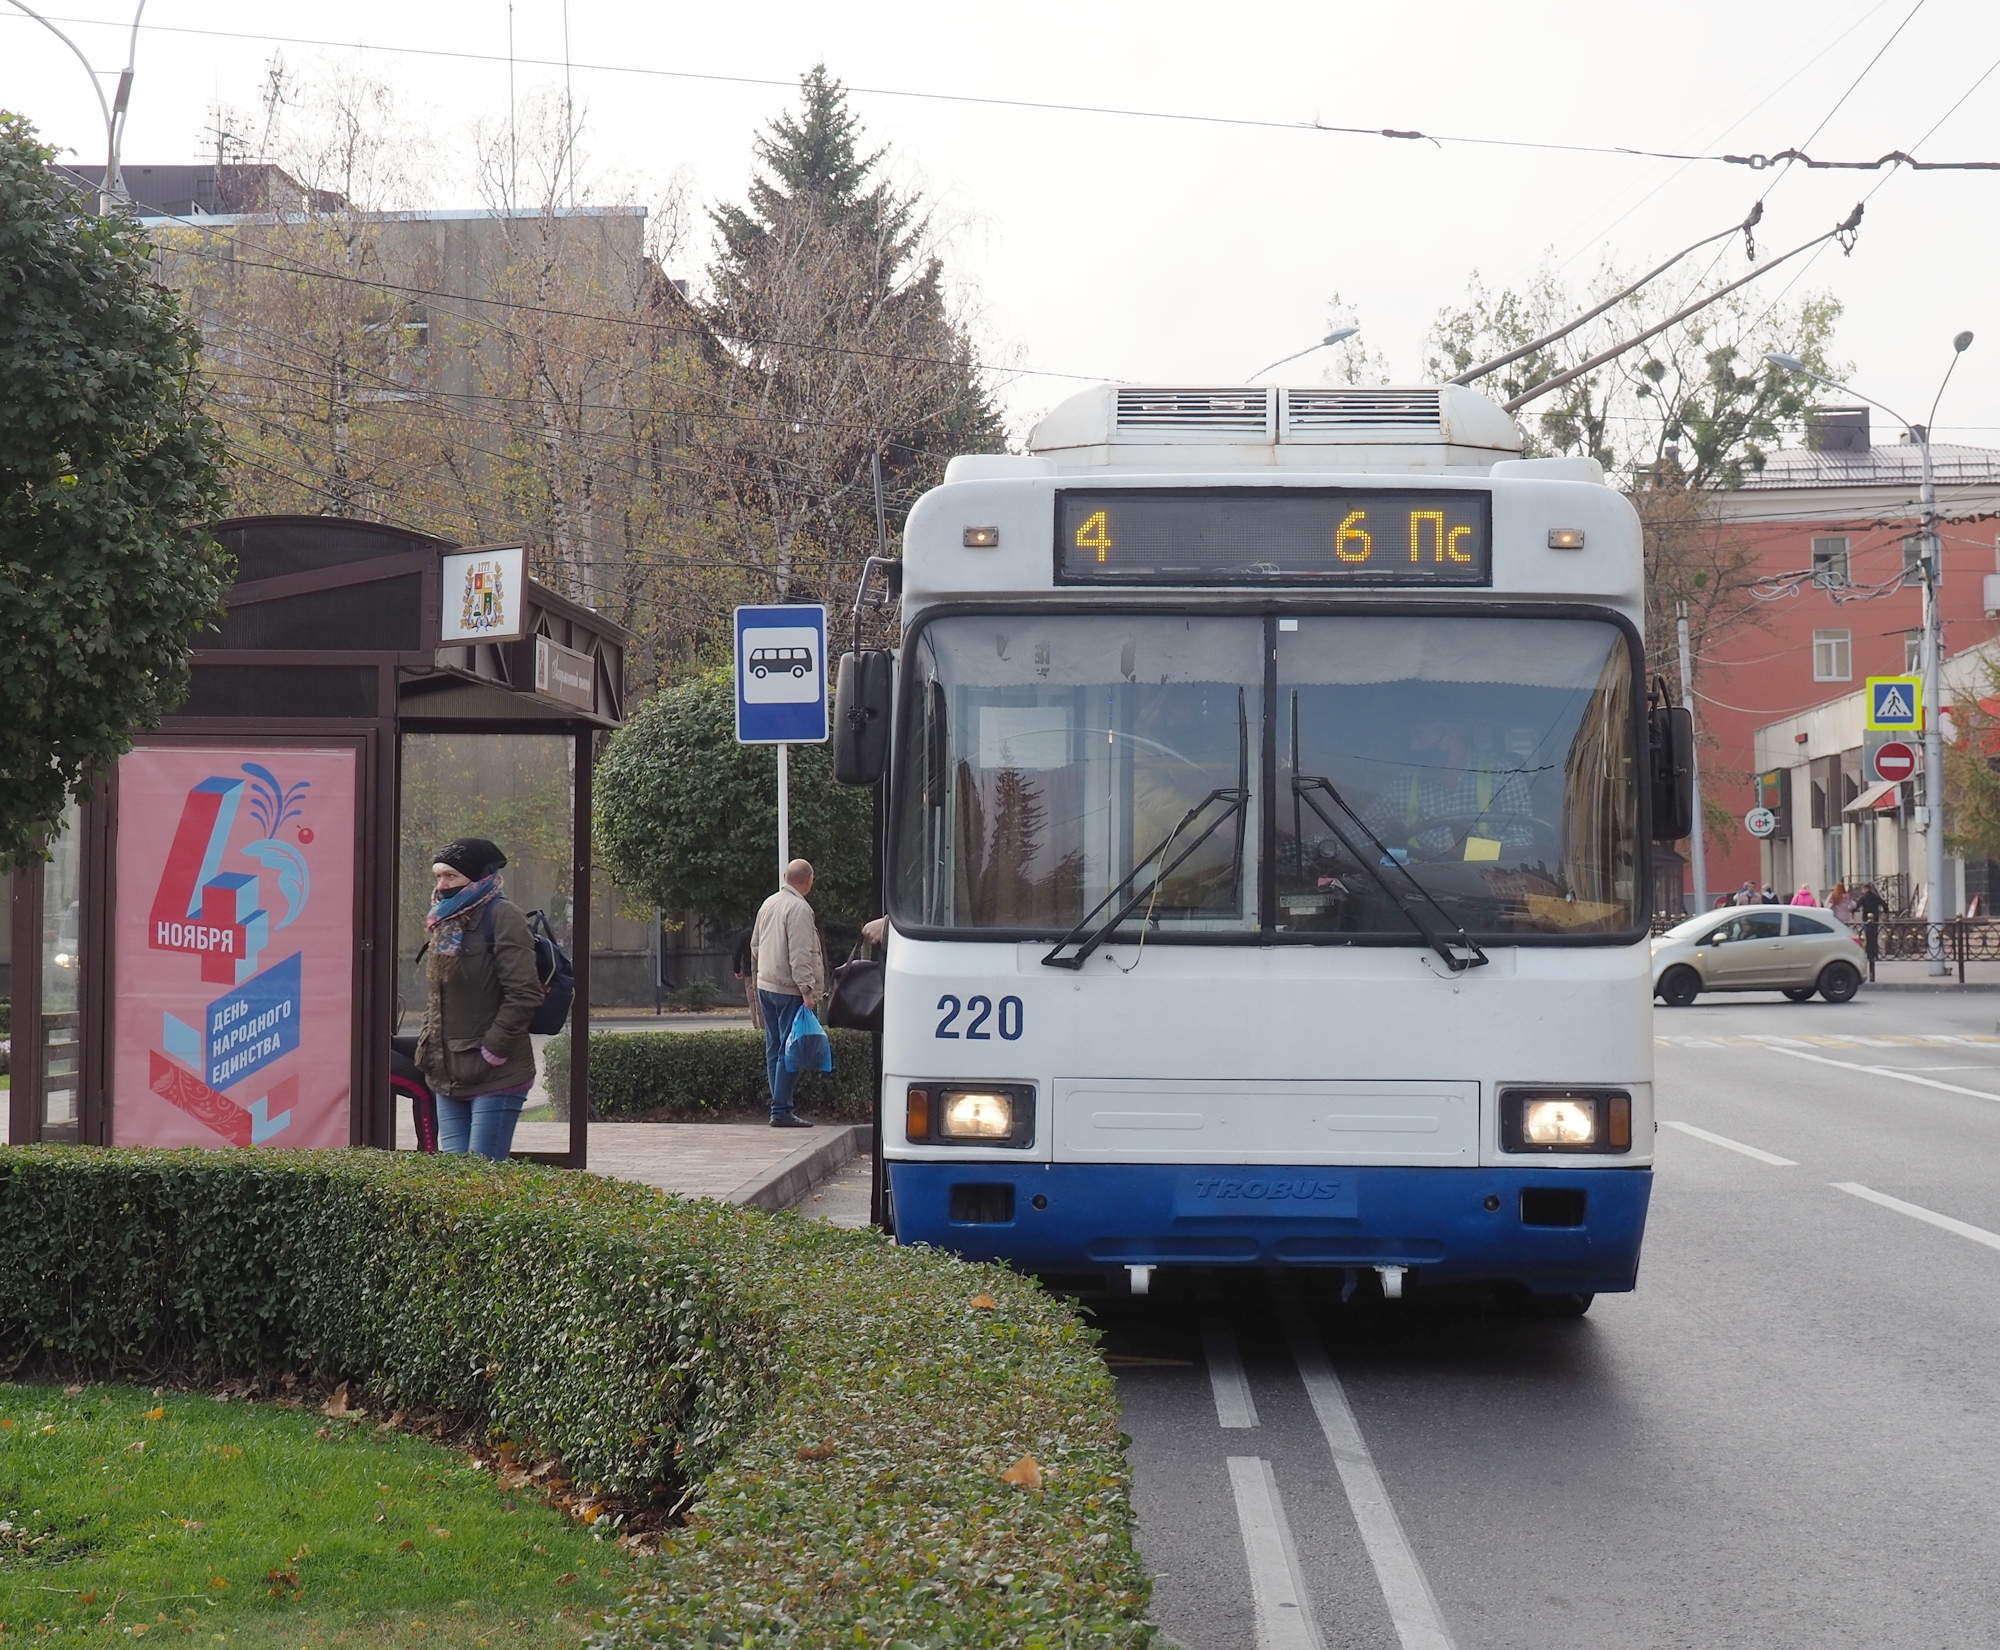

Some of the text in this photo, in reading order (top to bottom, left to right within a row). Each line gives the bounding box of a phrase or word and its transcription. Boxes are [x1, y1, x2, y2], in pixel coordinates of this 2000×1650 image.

[1076, 511, 1471, 562] 4 6 Пс
[478, 561, 490, 572] 1777
[149, 776, 268, 985] 4
[157, 921, 233, 953] НОЯБРЯ
[212, 999, 248, 1035] ДЕНЬ
[213, 1000, 291, 1058] НАРОДНОГО
[935, 994, 1023, 1041] 220
[212, 1032, 281, 1085] ЕДИНСТВА
[1195, 1178, 1339, 1200] TROBUS
